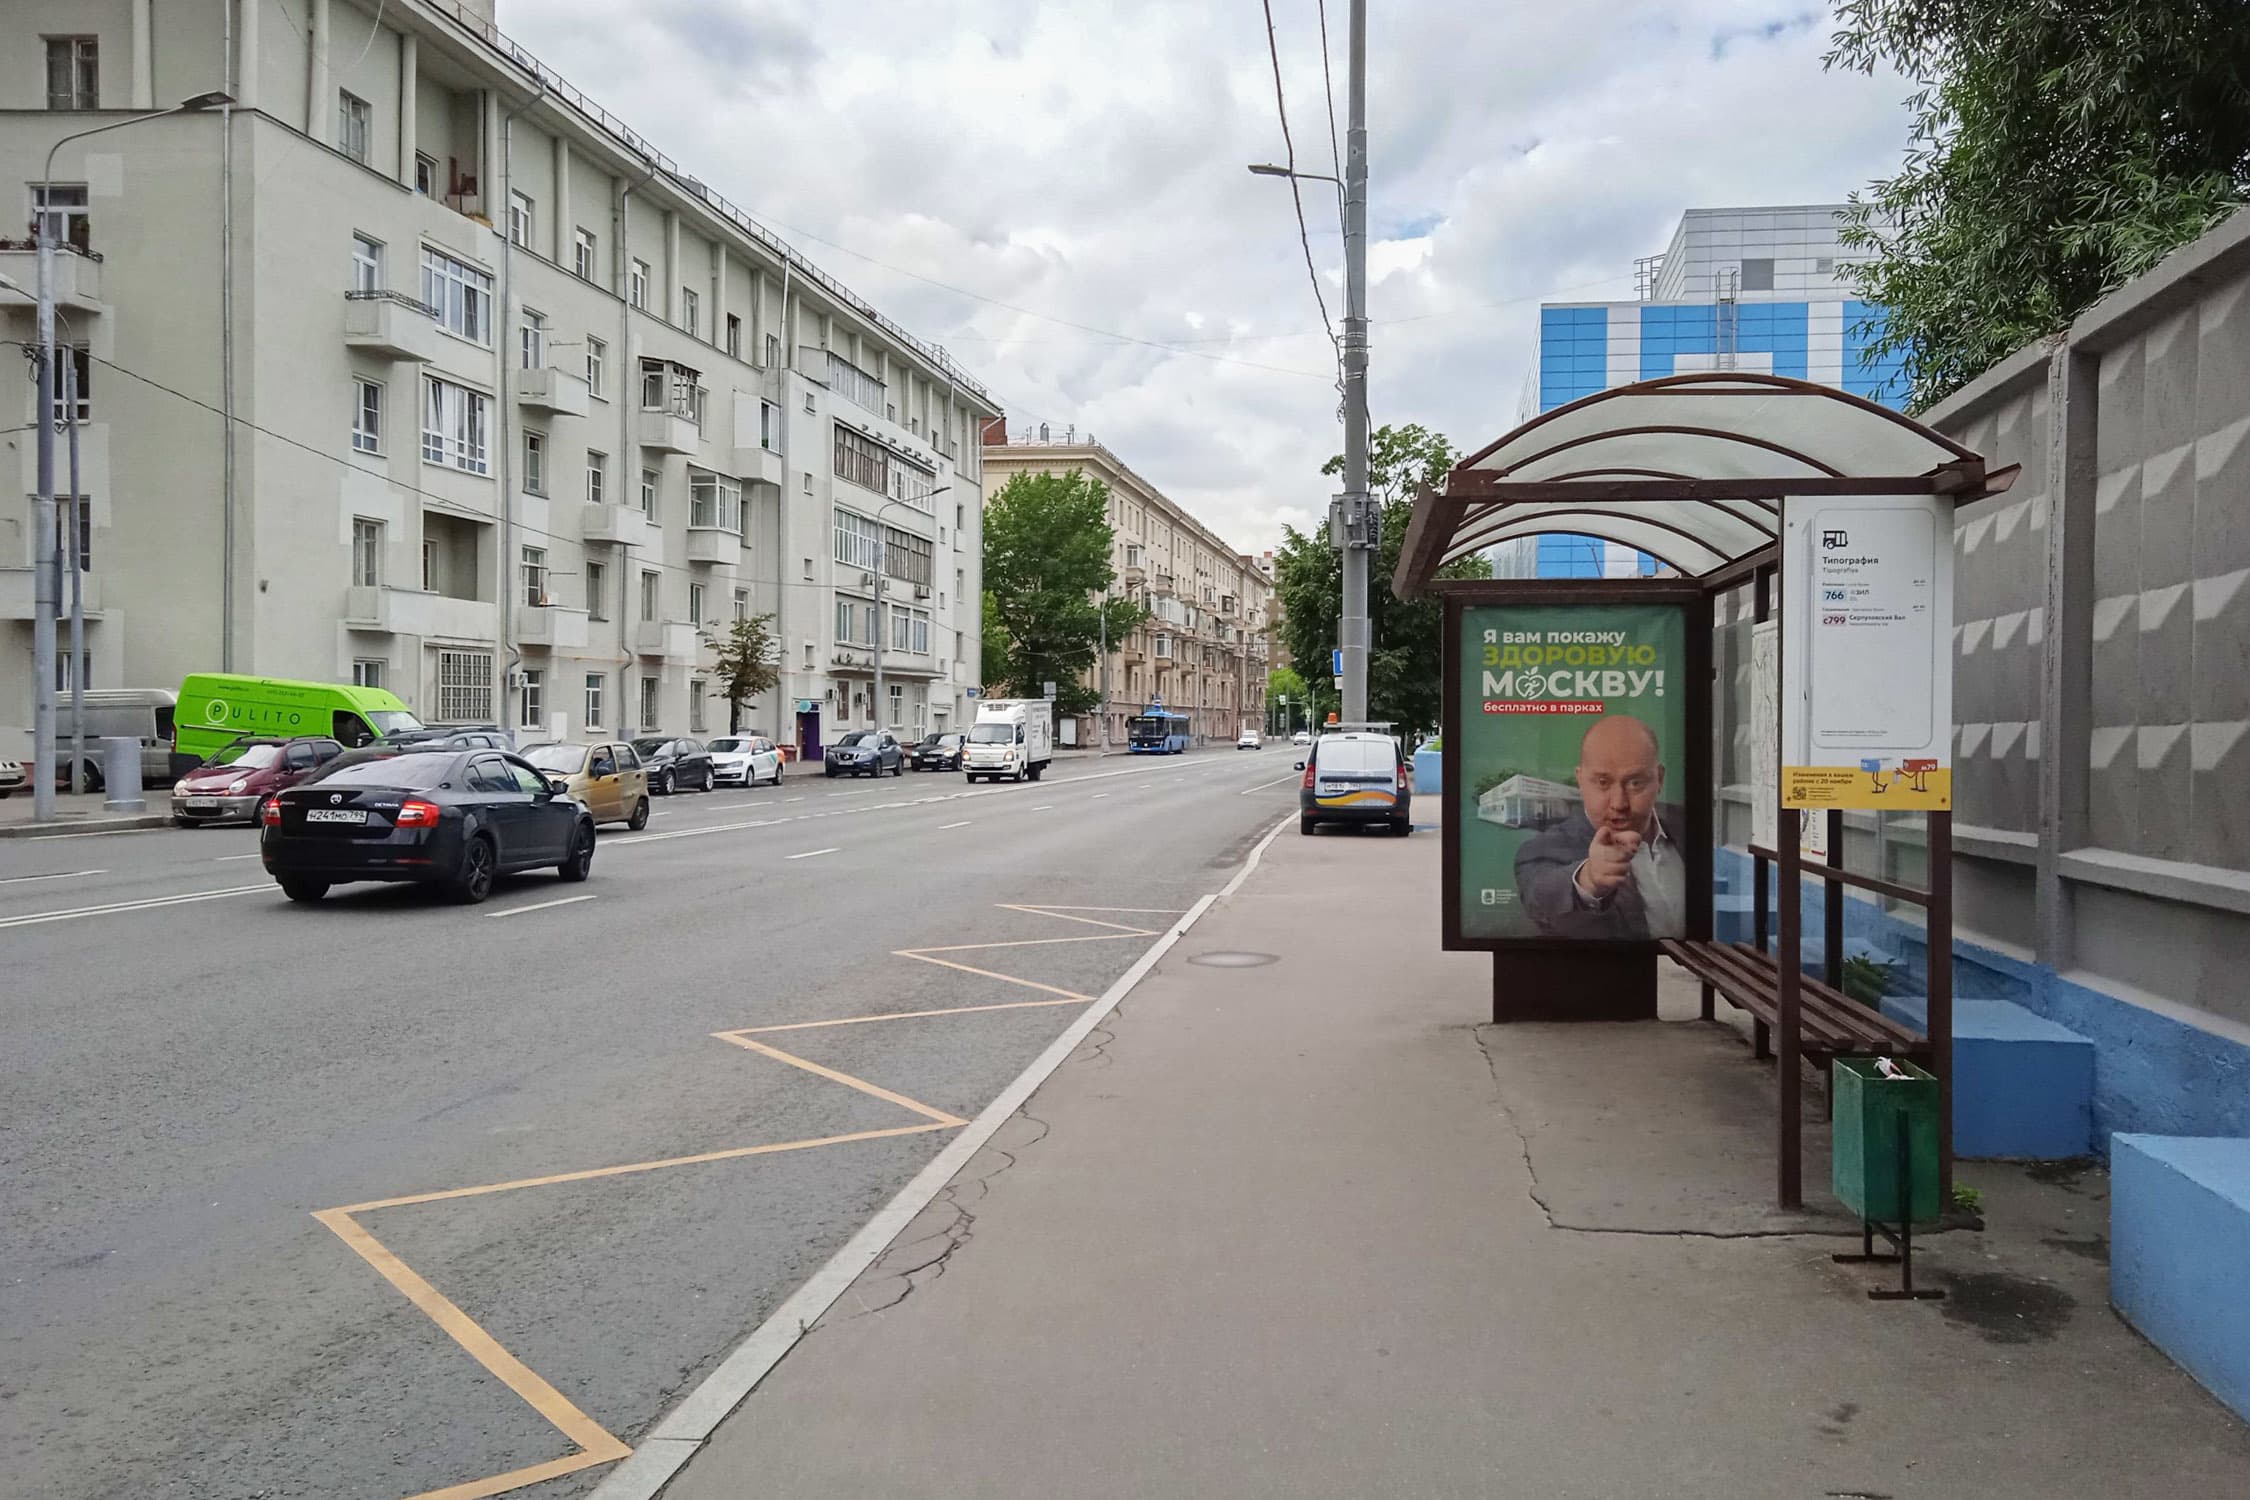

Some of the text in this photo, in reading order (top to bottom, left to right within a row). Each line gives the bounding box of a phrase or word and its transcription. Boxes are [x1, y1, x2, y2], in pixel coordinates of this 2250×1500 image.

[1822, 556, 1879, 566] Типография
[1825, 591, 1844, 600] 766
[1483, 629, 1626, 647] Я вам покажу
[1482, 644, 1657, 669] ЗДОРОВУЮ
[212, 704, 301, 725] PULITO
[1483, 702, 1602, 715] бесплатно в парках
